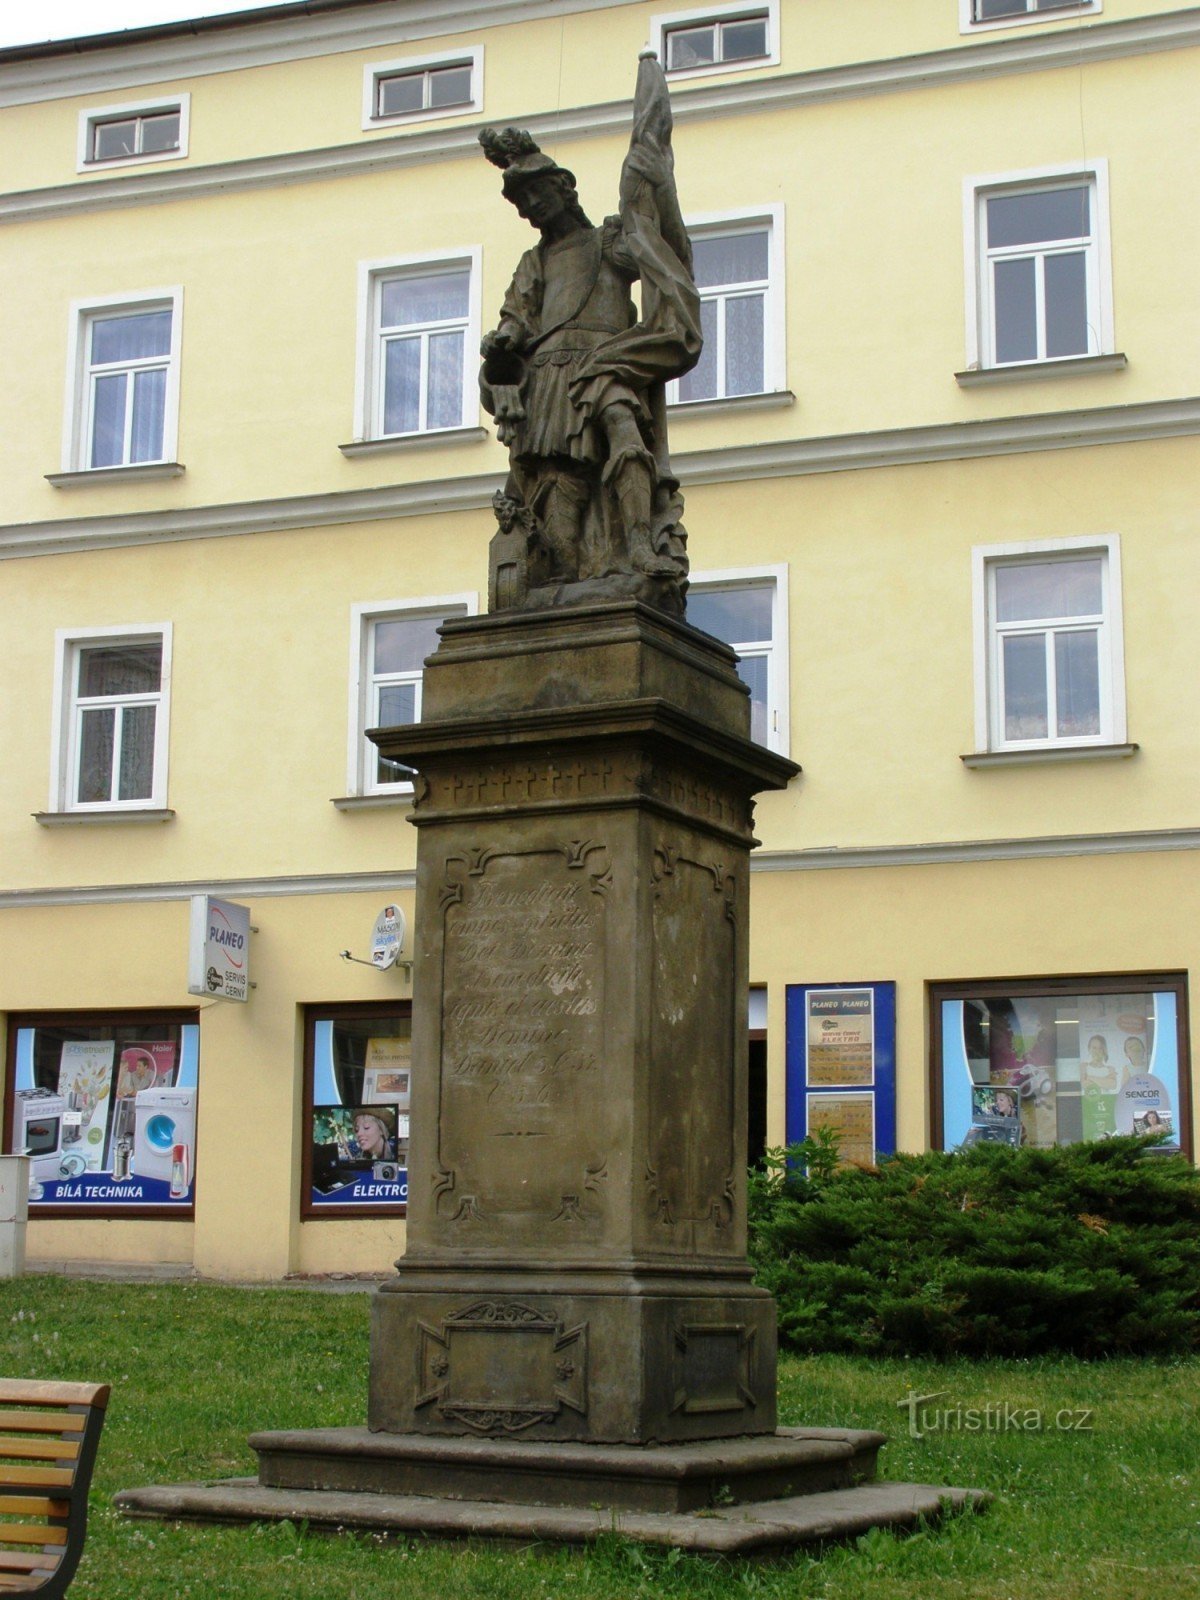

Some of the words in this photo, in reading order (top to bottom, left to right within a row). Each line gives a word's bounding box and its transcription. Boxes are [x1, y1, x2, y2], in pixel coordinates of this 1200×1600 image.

[210, 926, 244, 950] PLANEO
[225, 970, 246, 985] SERVIS
[225, 983, 245, 999] ČERNÝ
[812, 1001, 838, 1009] PLANEO
[842, 1000, 869, 1008] PLANEO
[152, 1044, 173, 1052] Haier
[1125, 1090, 1160, 1099] SENCOR
[56, 1184, 82, 1198] BÍLÁ
[85, 1185, 143, 1198] TECHNIKA
[353, 1184, 409, 1197] ELEKTRO
